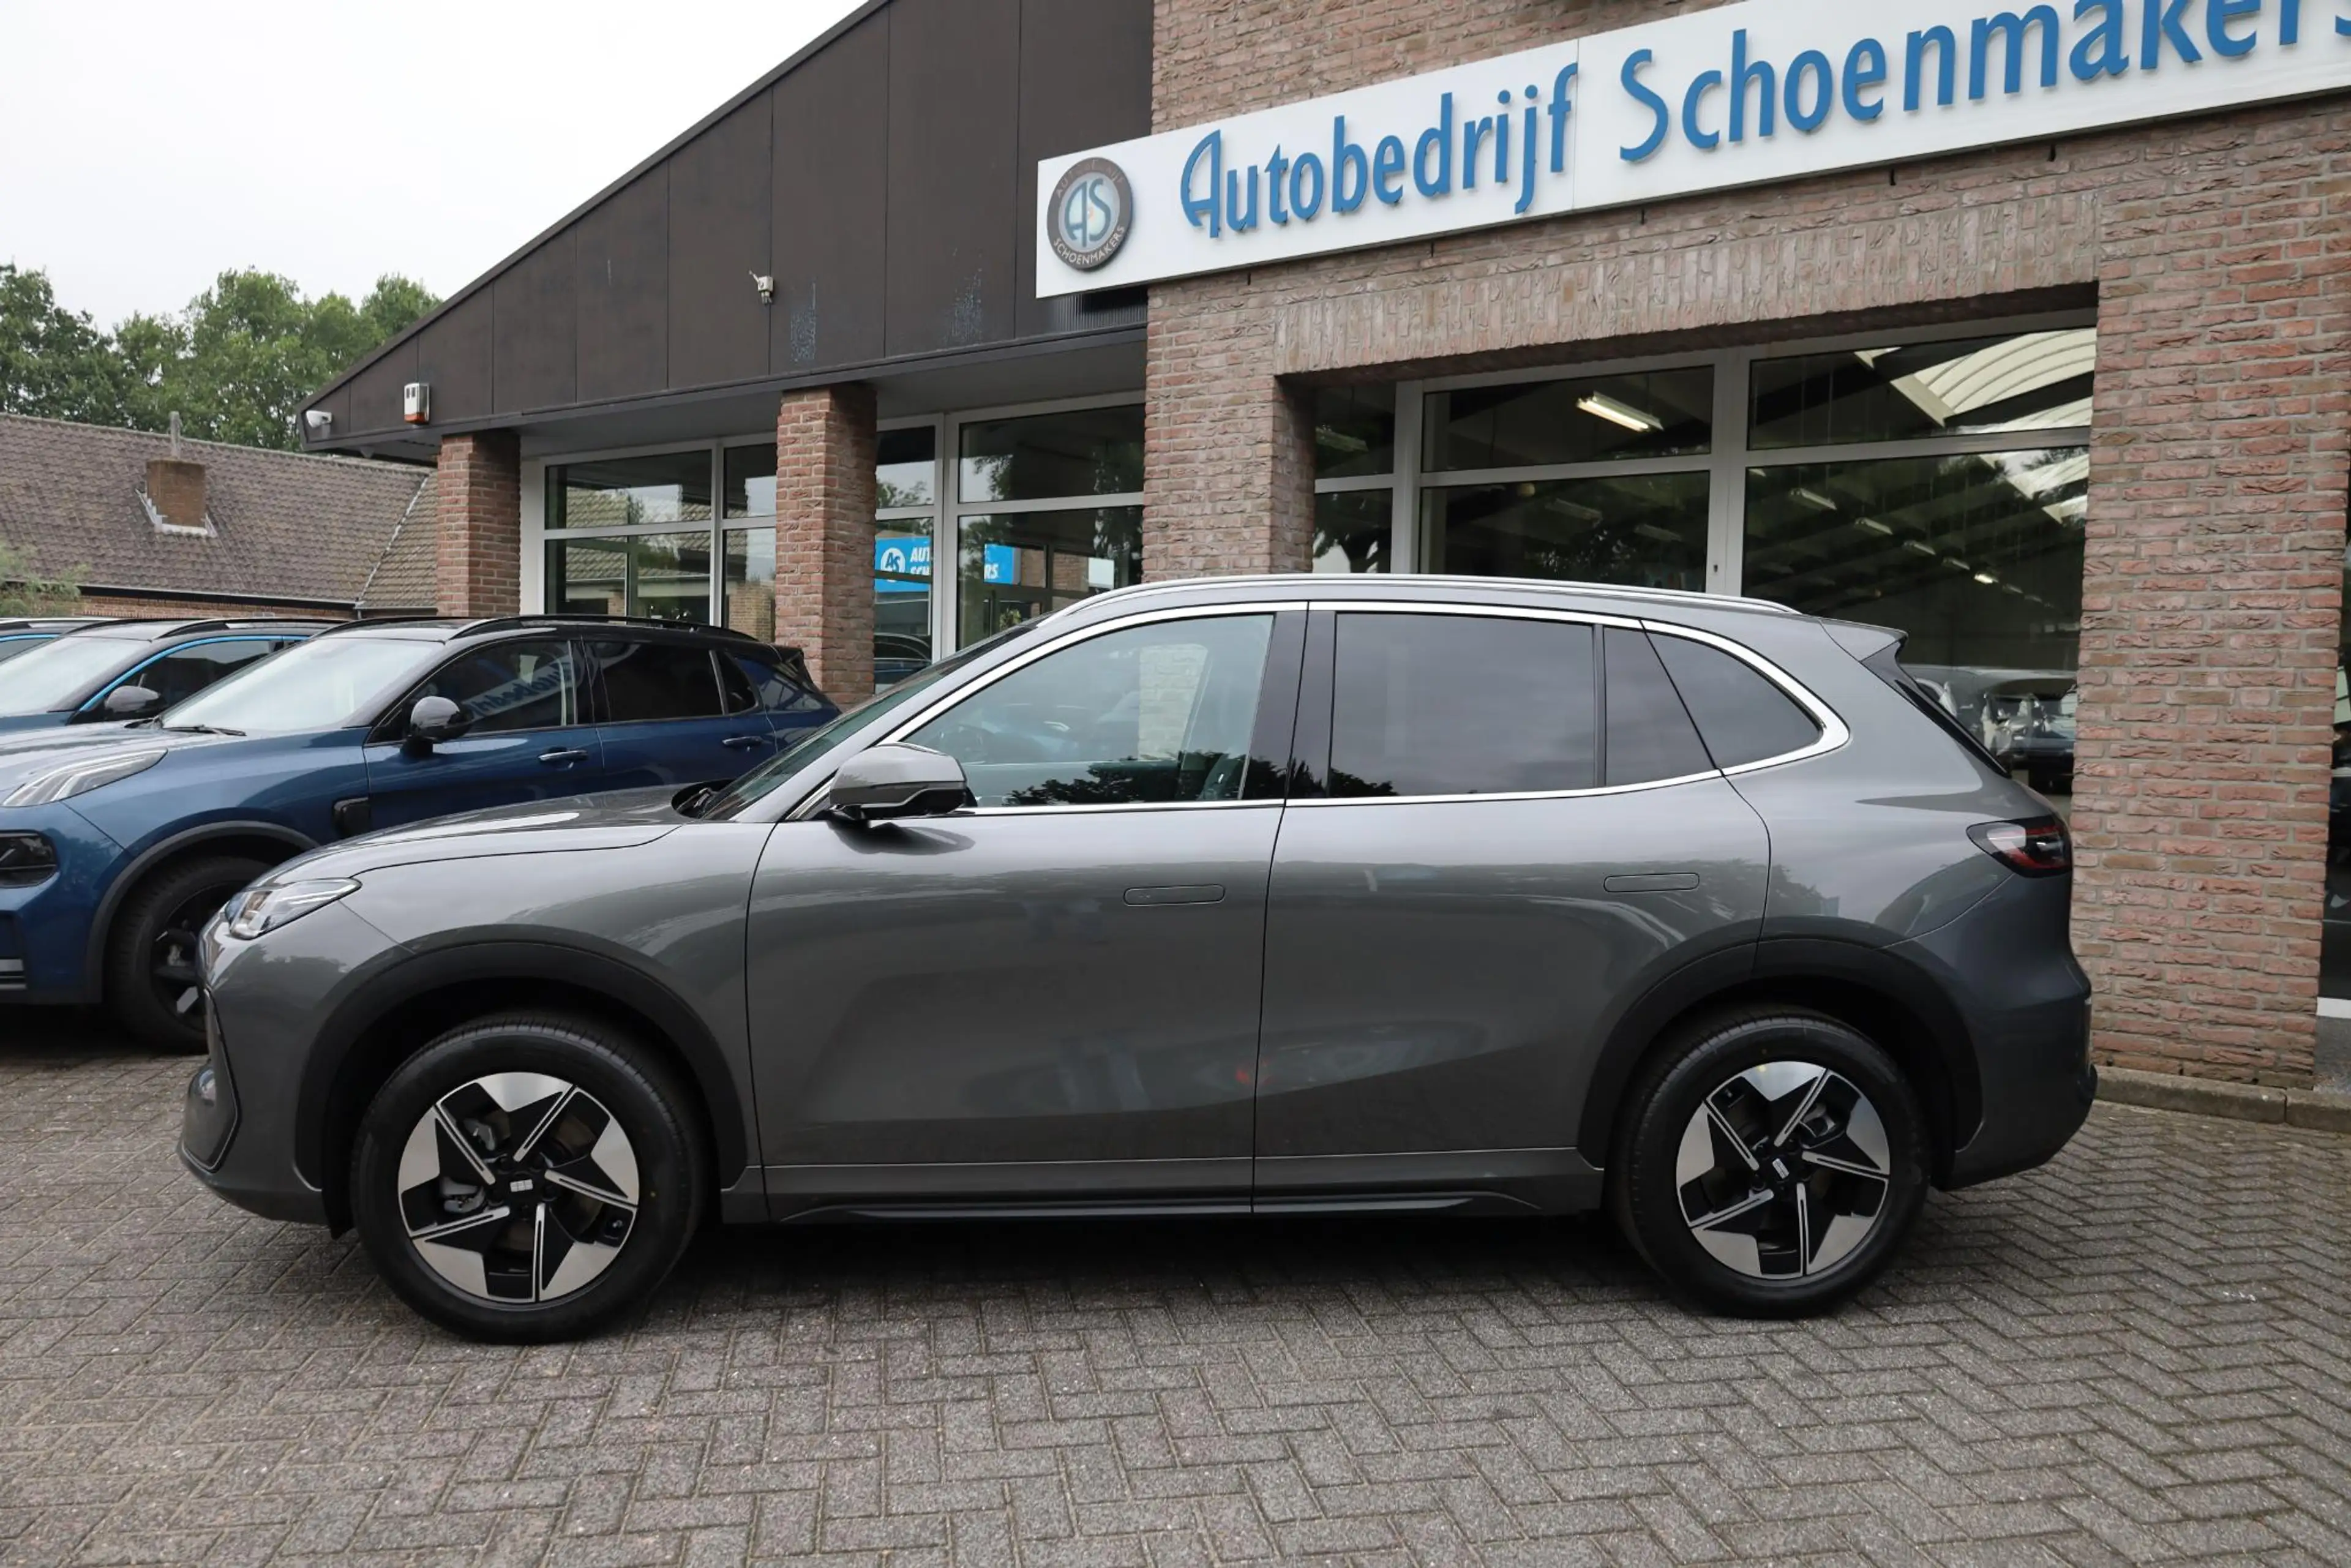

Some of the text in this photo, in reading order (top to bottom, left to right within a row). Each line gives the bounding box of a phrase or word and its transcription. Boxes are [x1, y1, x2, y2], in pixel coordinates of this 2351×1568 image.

[1181, 0, 2351, 238] Autobedrijf Schoenmake
[1053, 225, 1125, 265] SCHOENMAKERS
[1064, 178, 1111, 247] AS
